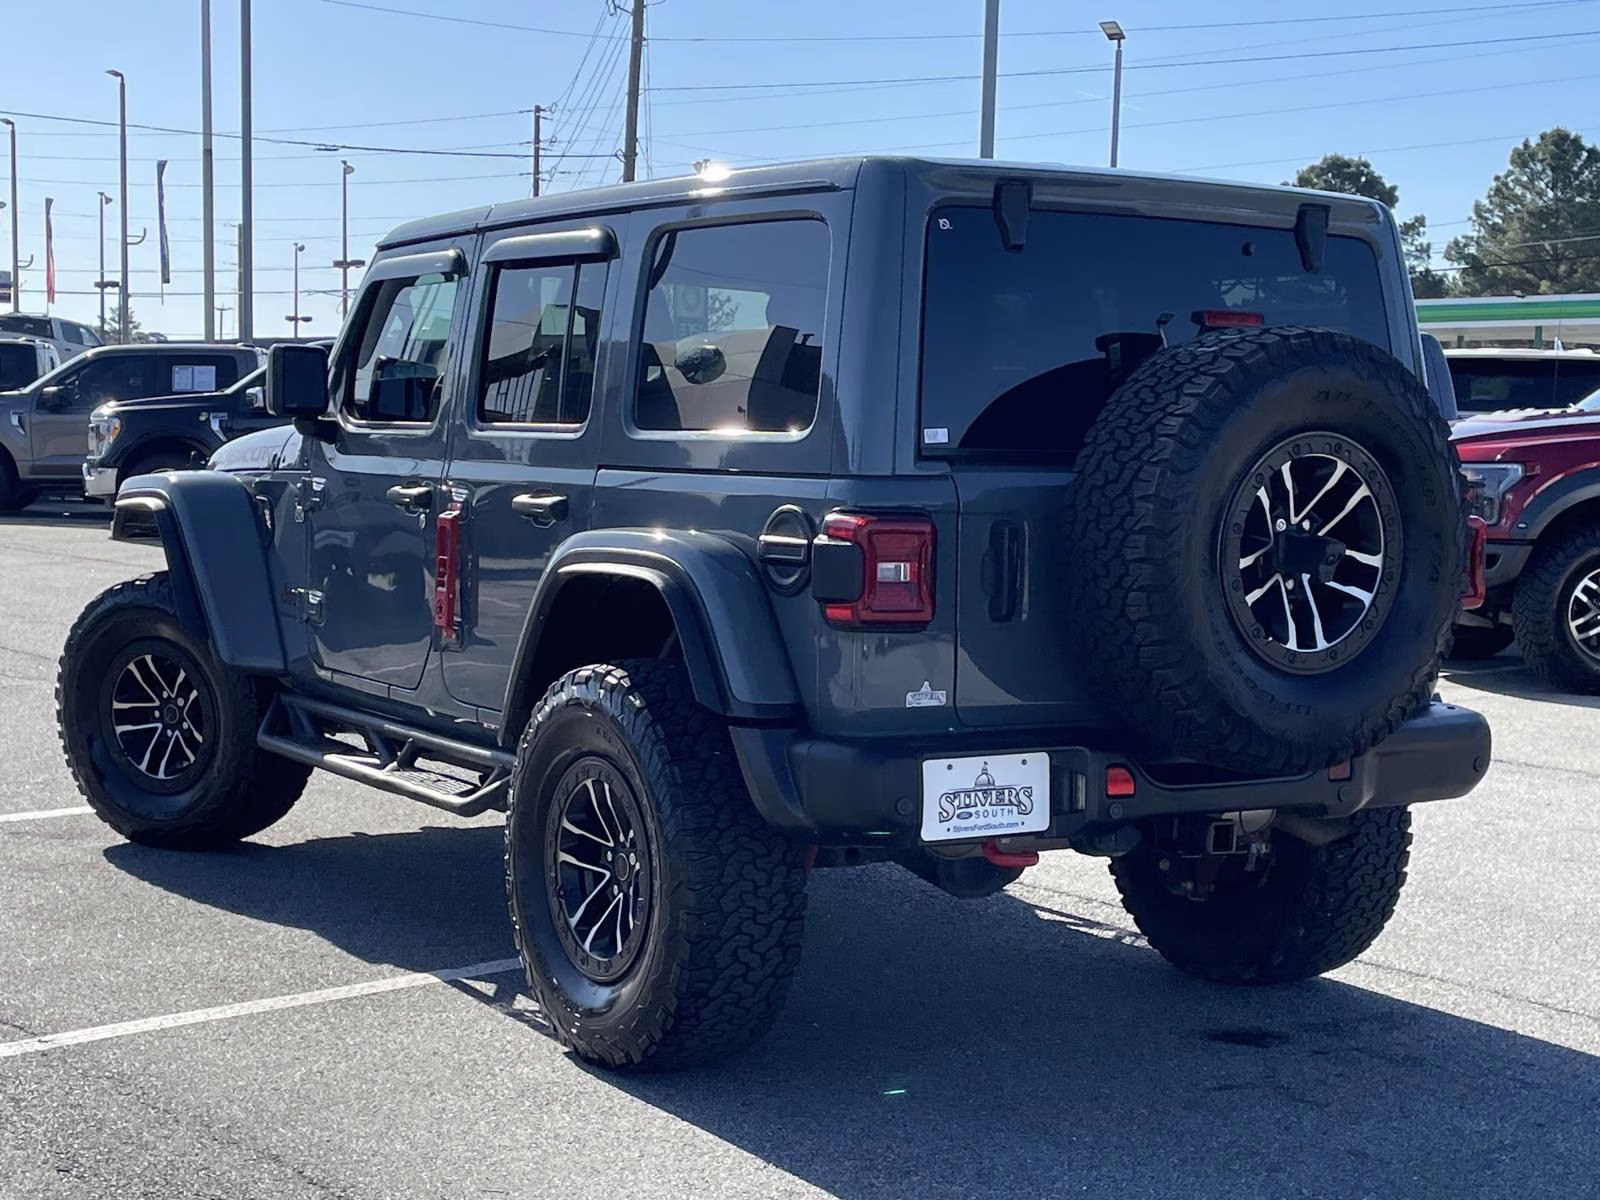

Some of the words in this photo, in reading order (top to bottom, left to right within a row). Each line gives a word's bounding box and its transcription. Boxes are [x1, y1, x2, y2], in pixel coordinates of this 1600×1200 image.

[939, 786, 1033, 823] STIVERS
[974, 808, 1014, 820] SOUTH
[952, 821, 1020, 833] StiversFordSouth.com
